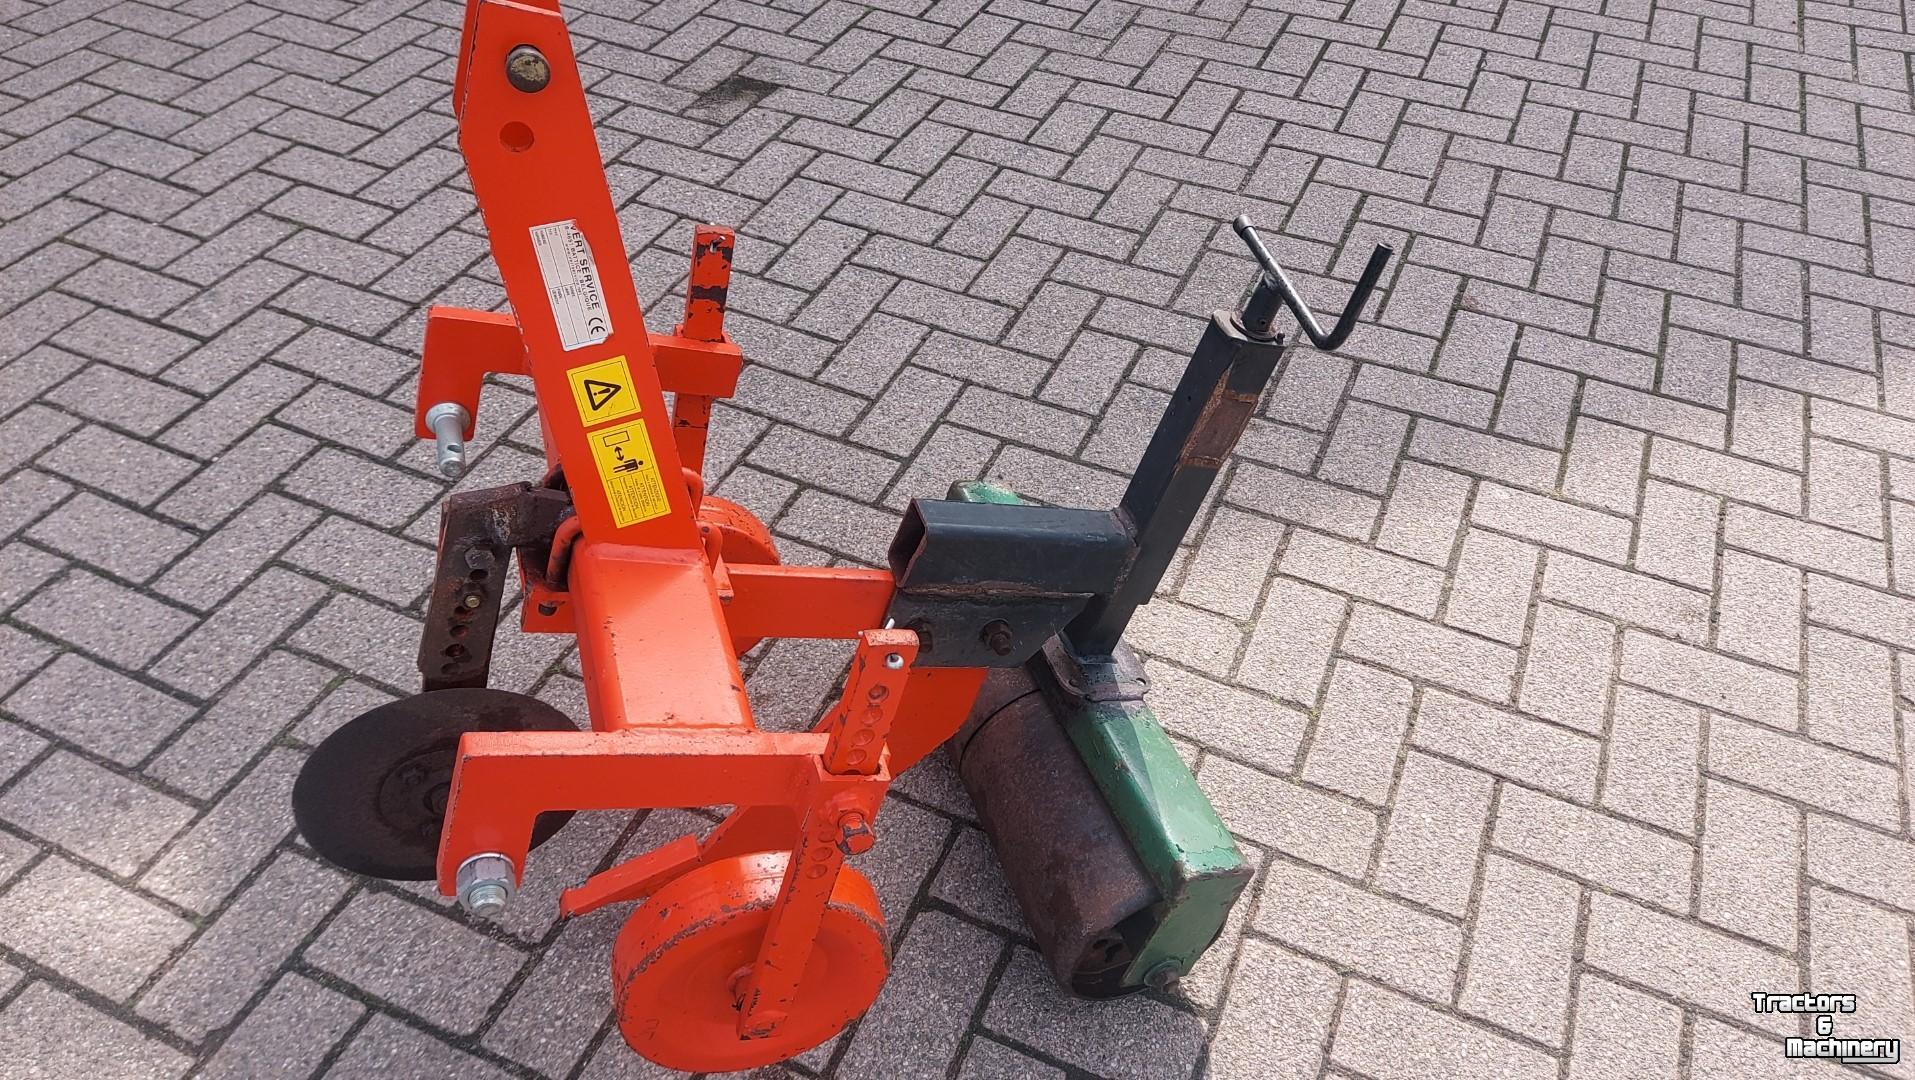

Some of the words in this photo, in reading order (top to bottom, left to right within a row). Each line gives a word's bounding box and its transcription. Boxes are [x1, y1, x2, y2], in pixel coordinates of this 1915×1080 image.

[578, 258, 600, 309] SERVICE
[578, 279, 592, 311] BELGIQUE
[588, 317, 606, 335] CE
